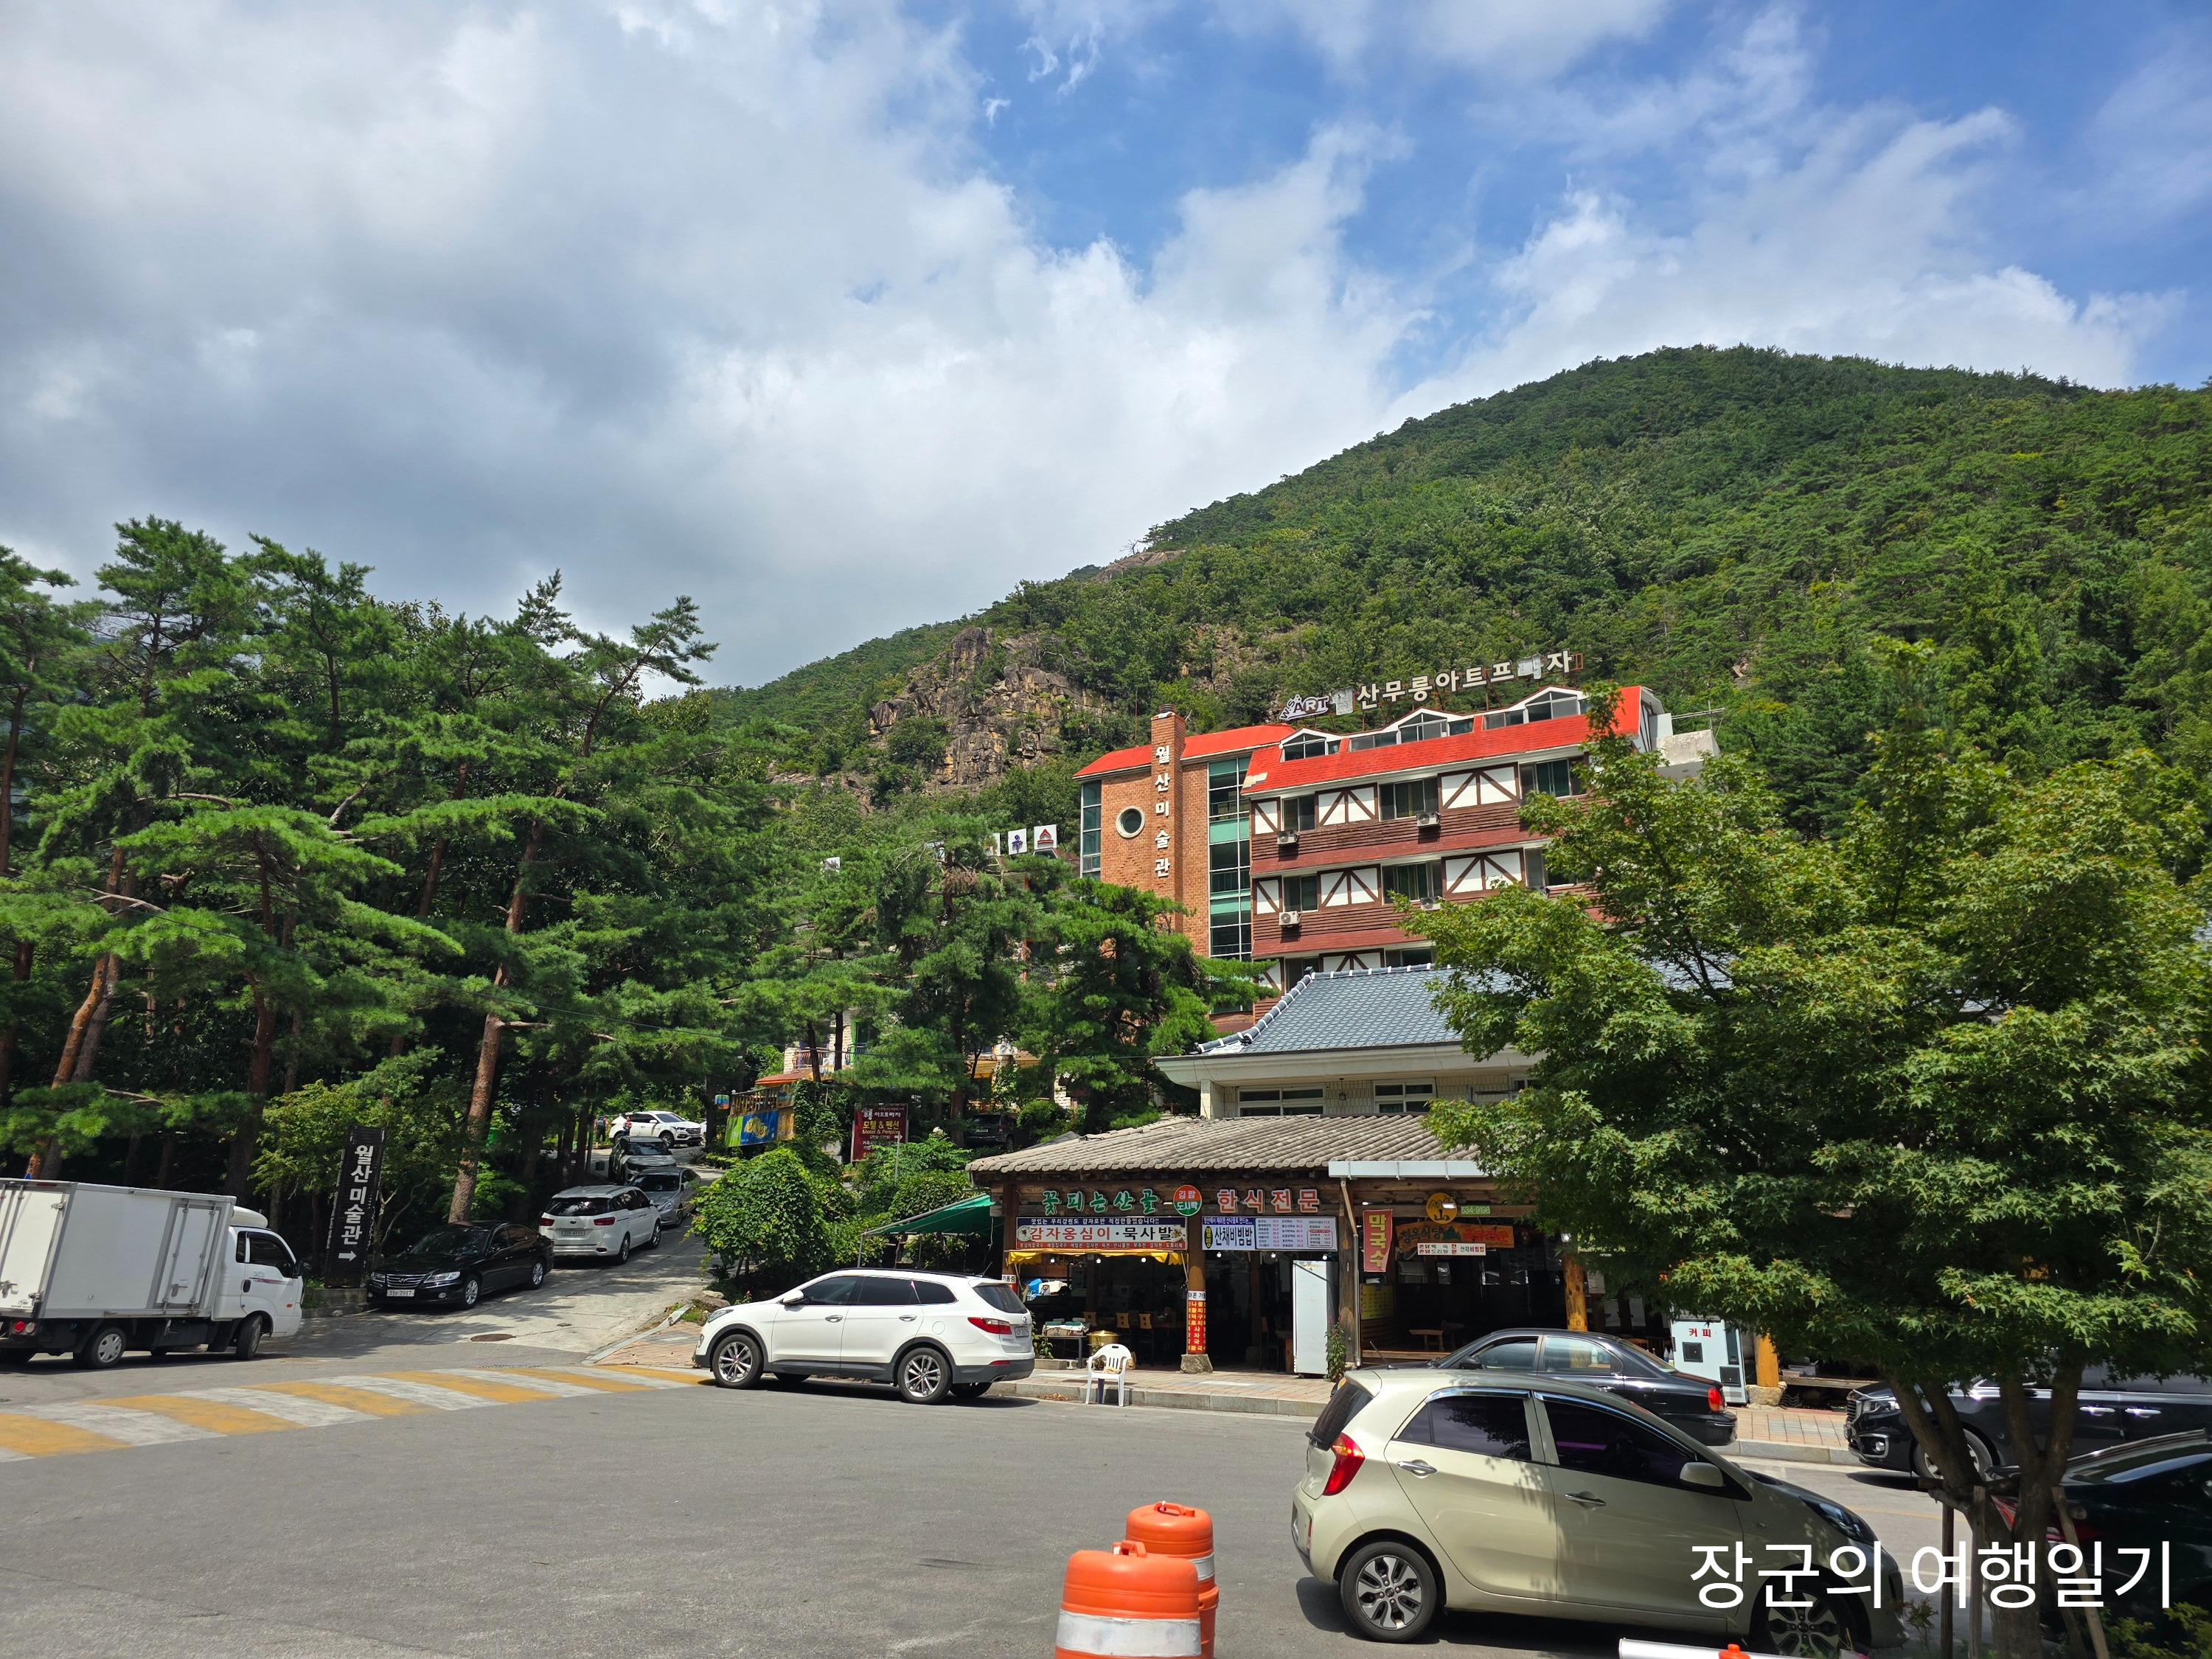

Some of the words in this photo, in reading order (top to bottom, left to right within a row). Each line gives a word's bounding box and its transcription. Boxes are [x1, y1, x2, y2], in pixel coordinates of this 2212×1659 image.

[1331, 649, 1572, 715] 산무릉아트프자
[1293, 697, 1328, 714] ART
[1155, 745, 1171, 877] 월산미술관
[863, 1121, 876, 1130] 모텔
[878, 1121, 884, 1129] &
[1179, 1190, 1196, 1199] 김밥
[1217, 1189, 1320, 1214] 한식전문
[1177, 1201, 1199, 1211] 도시락
[1461, 1206, 1490, 1214] 534-9198
[1214, 1226, 1253, 1246] 산채비빔밥
[1368, 1214, 1387, 1267] 막국수
[1688, 1328, 1711, 1338] 커피
